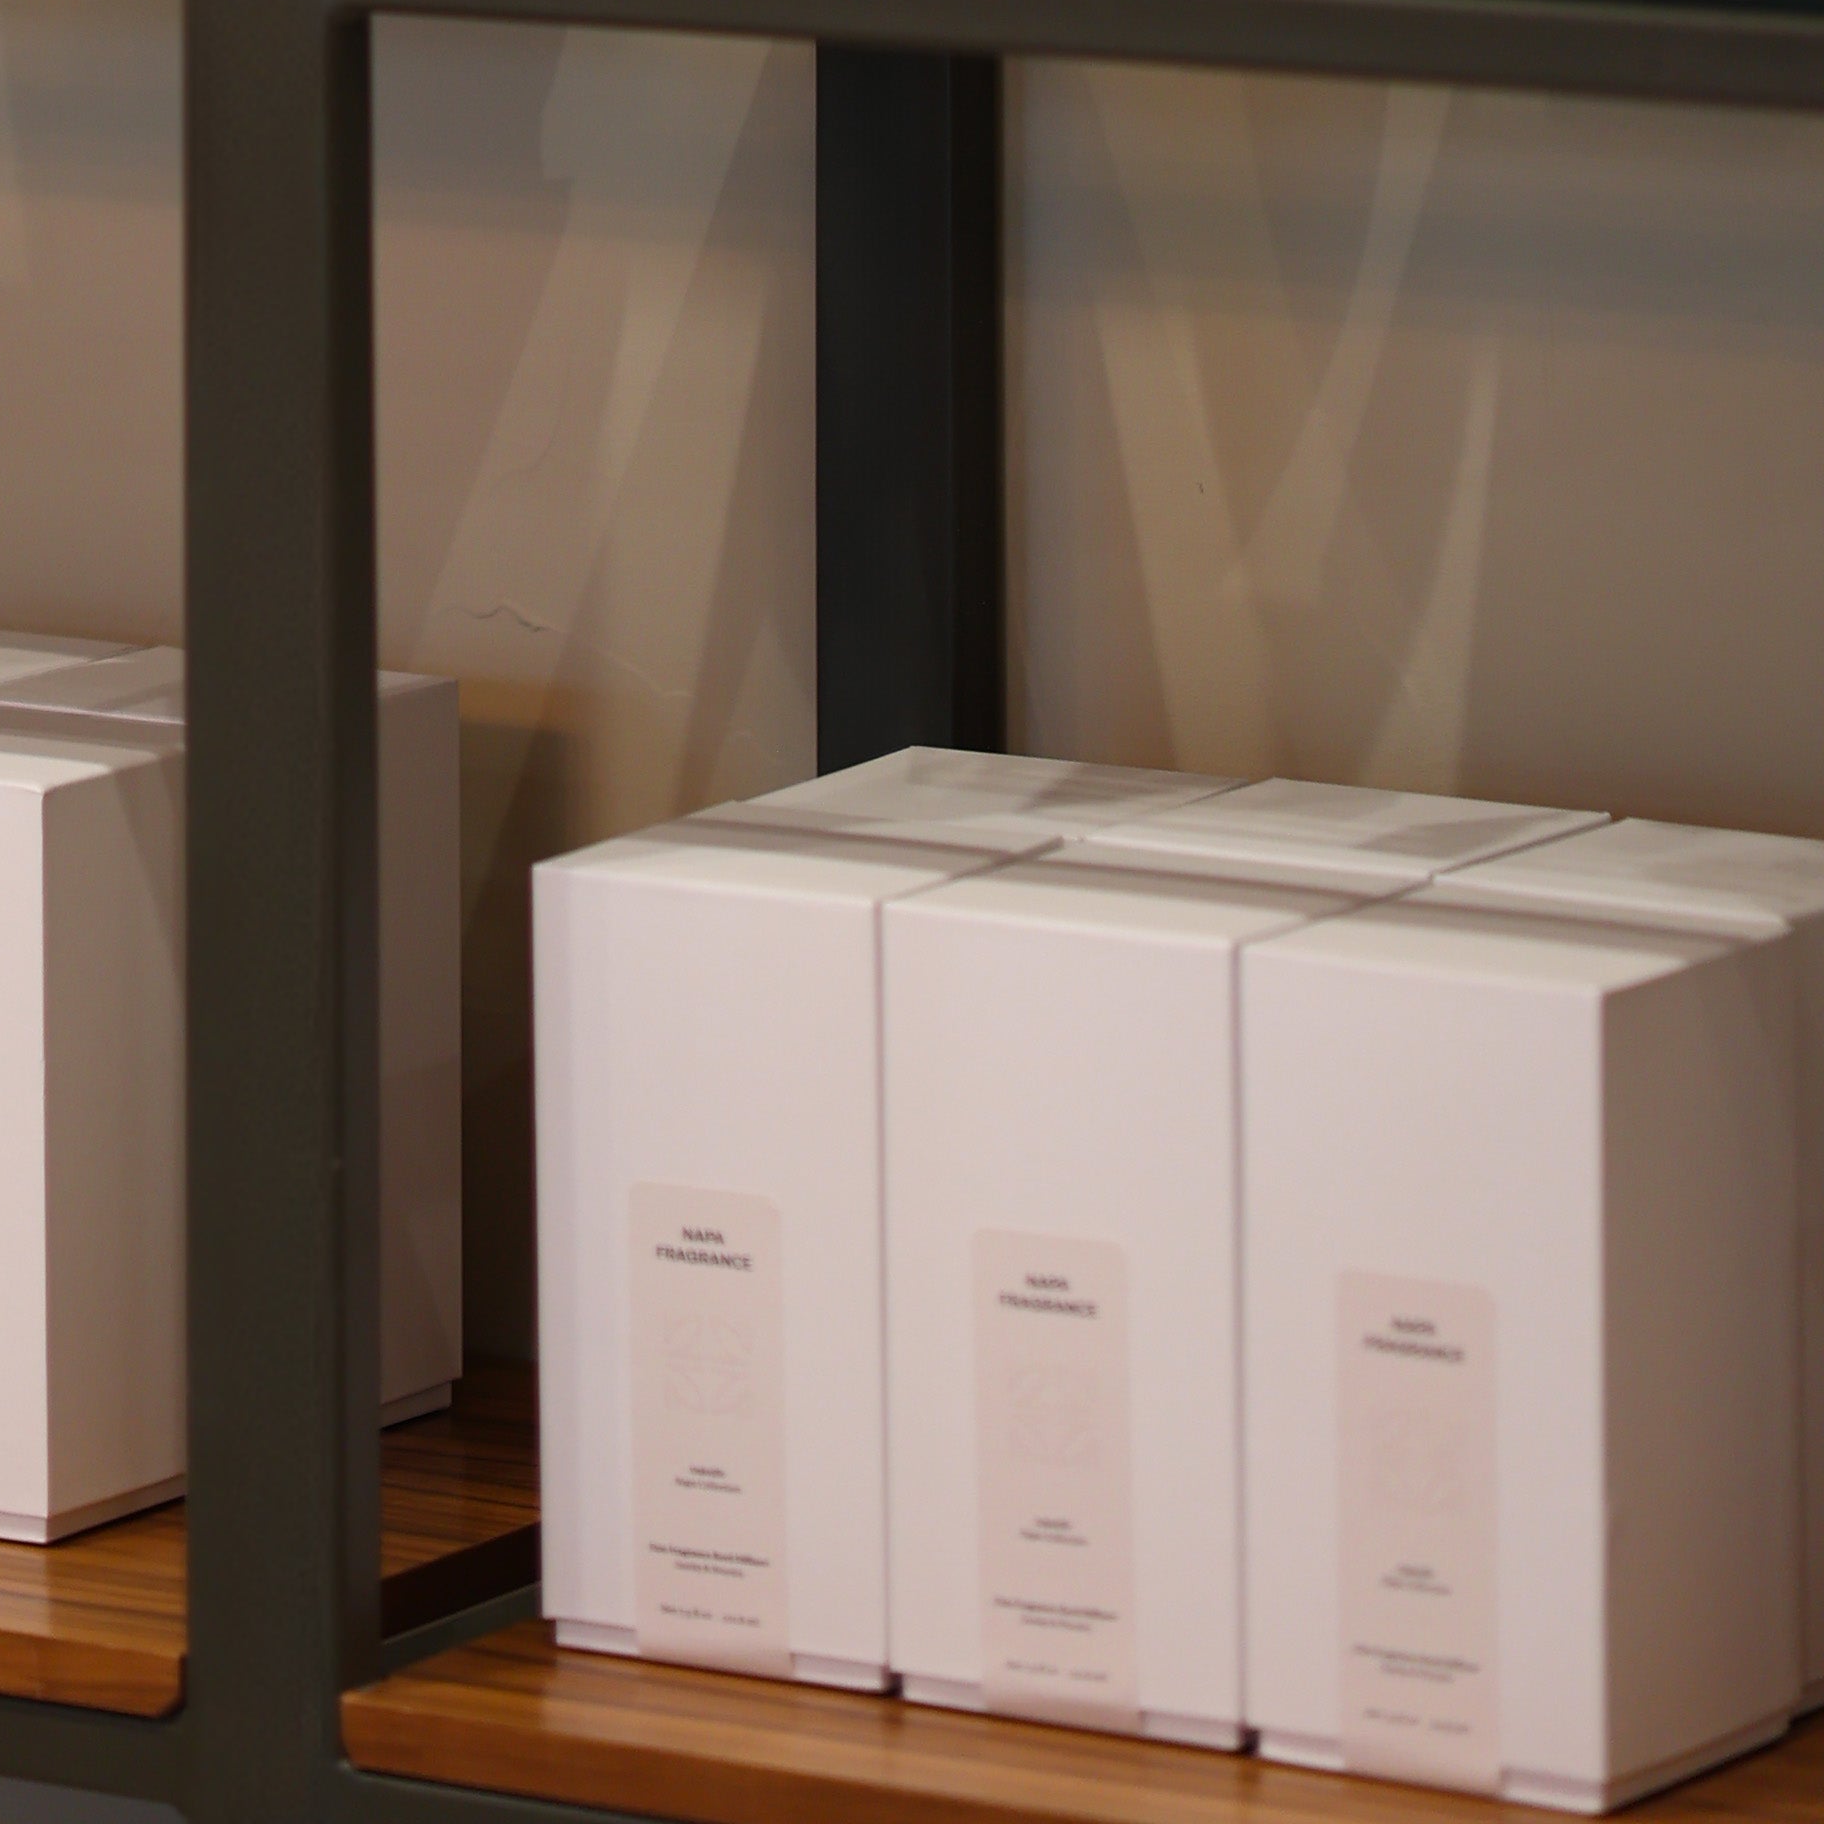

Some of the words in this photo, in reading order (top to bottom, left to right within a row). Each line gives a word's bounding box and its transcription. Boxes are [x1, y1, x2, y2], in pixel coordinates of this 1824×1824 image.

[681, 1225, 725, 1245] NAPA
[655, 1244, 753, 1272] FRAGRANCE
[1024, 1273, 1070, 1291] NAPA
[998, 1291, 1098, 1320] FRAGRANCE
